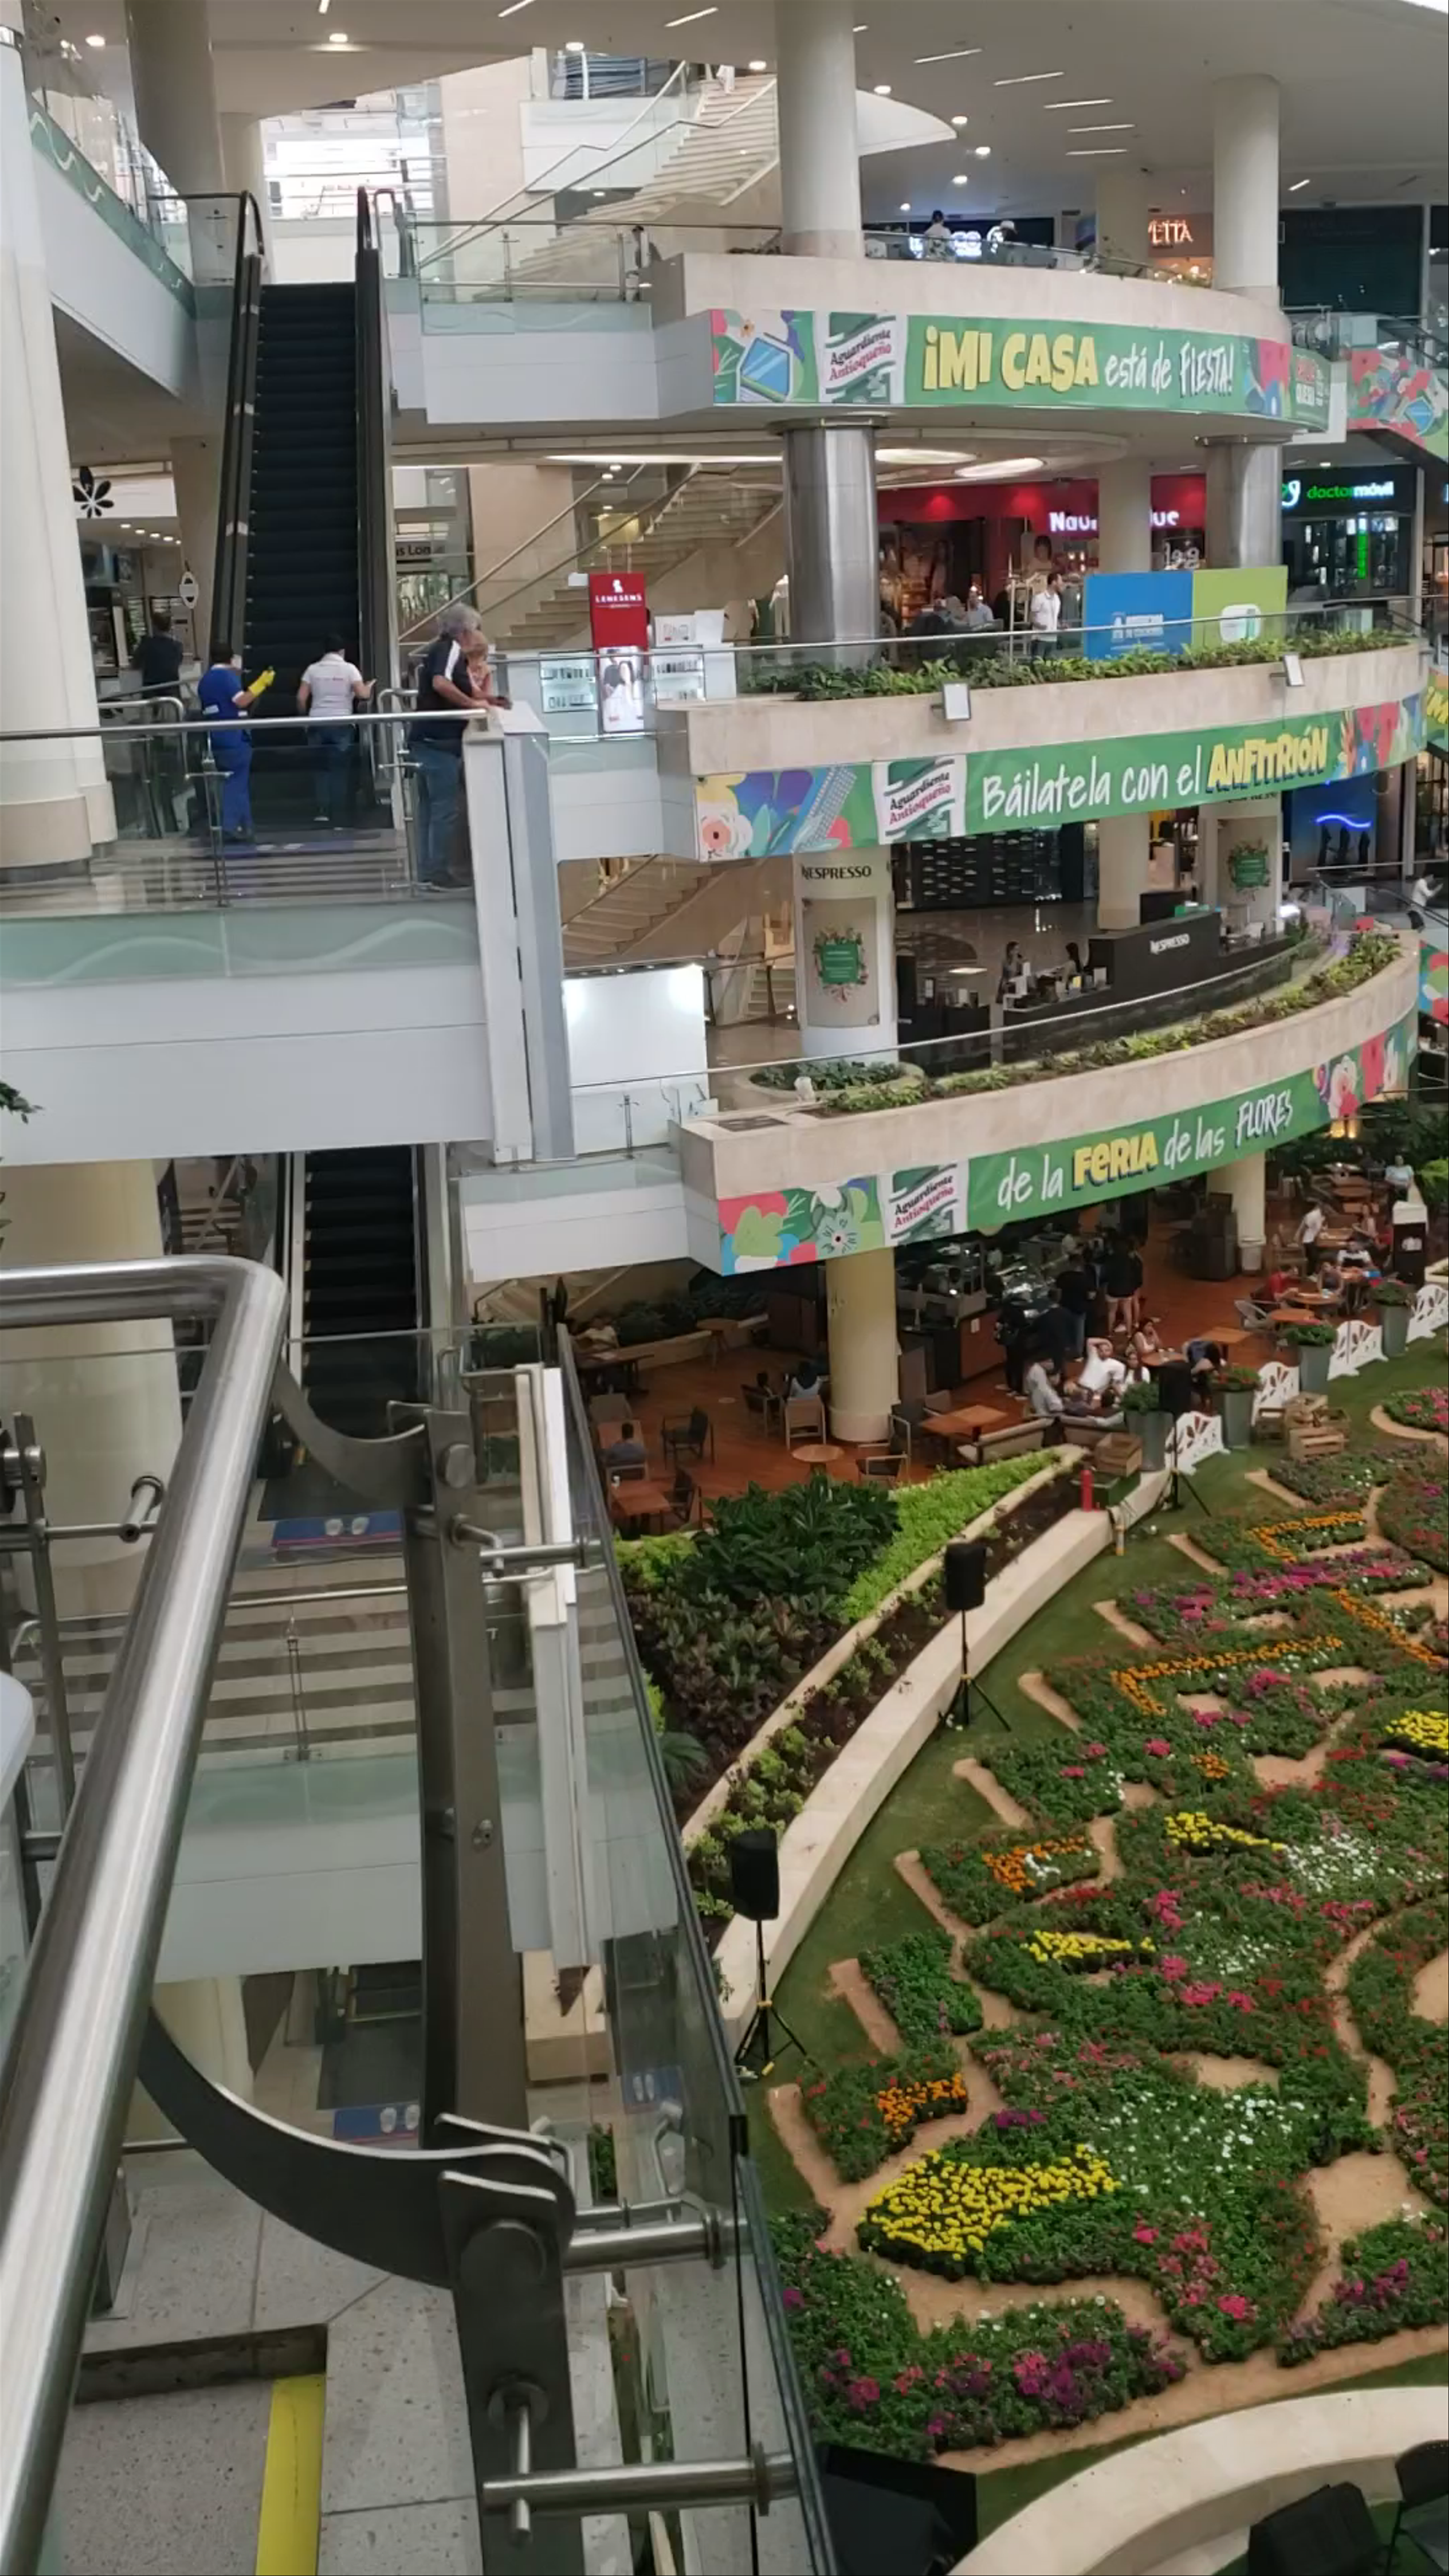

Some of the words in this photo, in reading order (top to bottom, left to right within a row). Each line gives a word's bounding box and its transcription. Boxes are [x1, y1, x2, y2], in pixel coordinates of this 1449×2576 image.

[830, 341, 891, 381] Antioqueño
[831, 330, 891, 365] Aguardiente
[923, 325, 992, 391] ¡MI
[1001, 333, 1099, 392] CASA
[1105, 343, 1147, 389] está
[1151, 340, 1172, 394] de
[1180, 340, 1234, 397] FIESTA!
[890, 772, 949, 810] Aguardiente
[983, 756, 1111, 819] Báilatela
[1121, 763, 1168, 803] con
[1176, 745, 1201, 795] el
[1206, 725, 1328, 793] ANFITRIÓN
[890, 783, 951, 825] Antioqueño
[801, 865, 872, 880] NESPRESSO
[998, 1157, 1033, 1211] de
[1041, 1153, 1063, 1201] la
[1164, 1118, 1192, 1170] de
[1195, 1116, 1225, 1160] las
[1235, 1089, 1293, 1148] FLORES
[895, 1176, 953, 1215] Aguardiente
